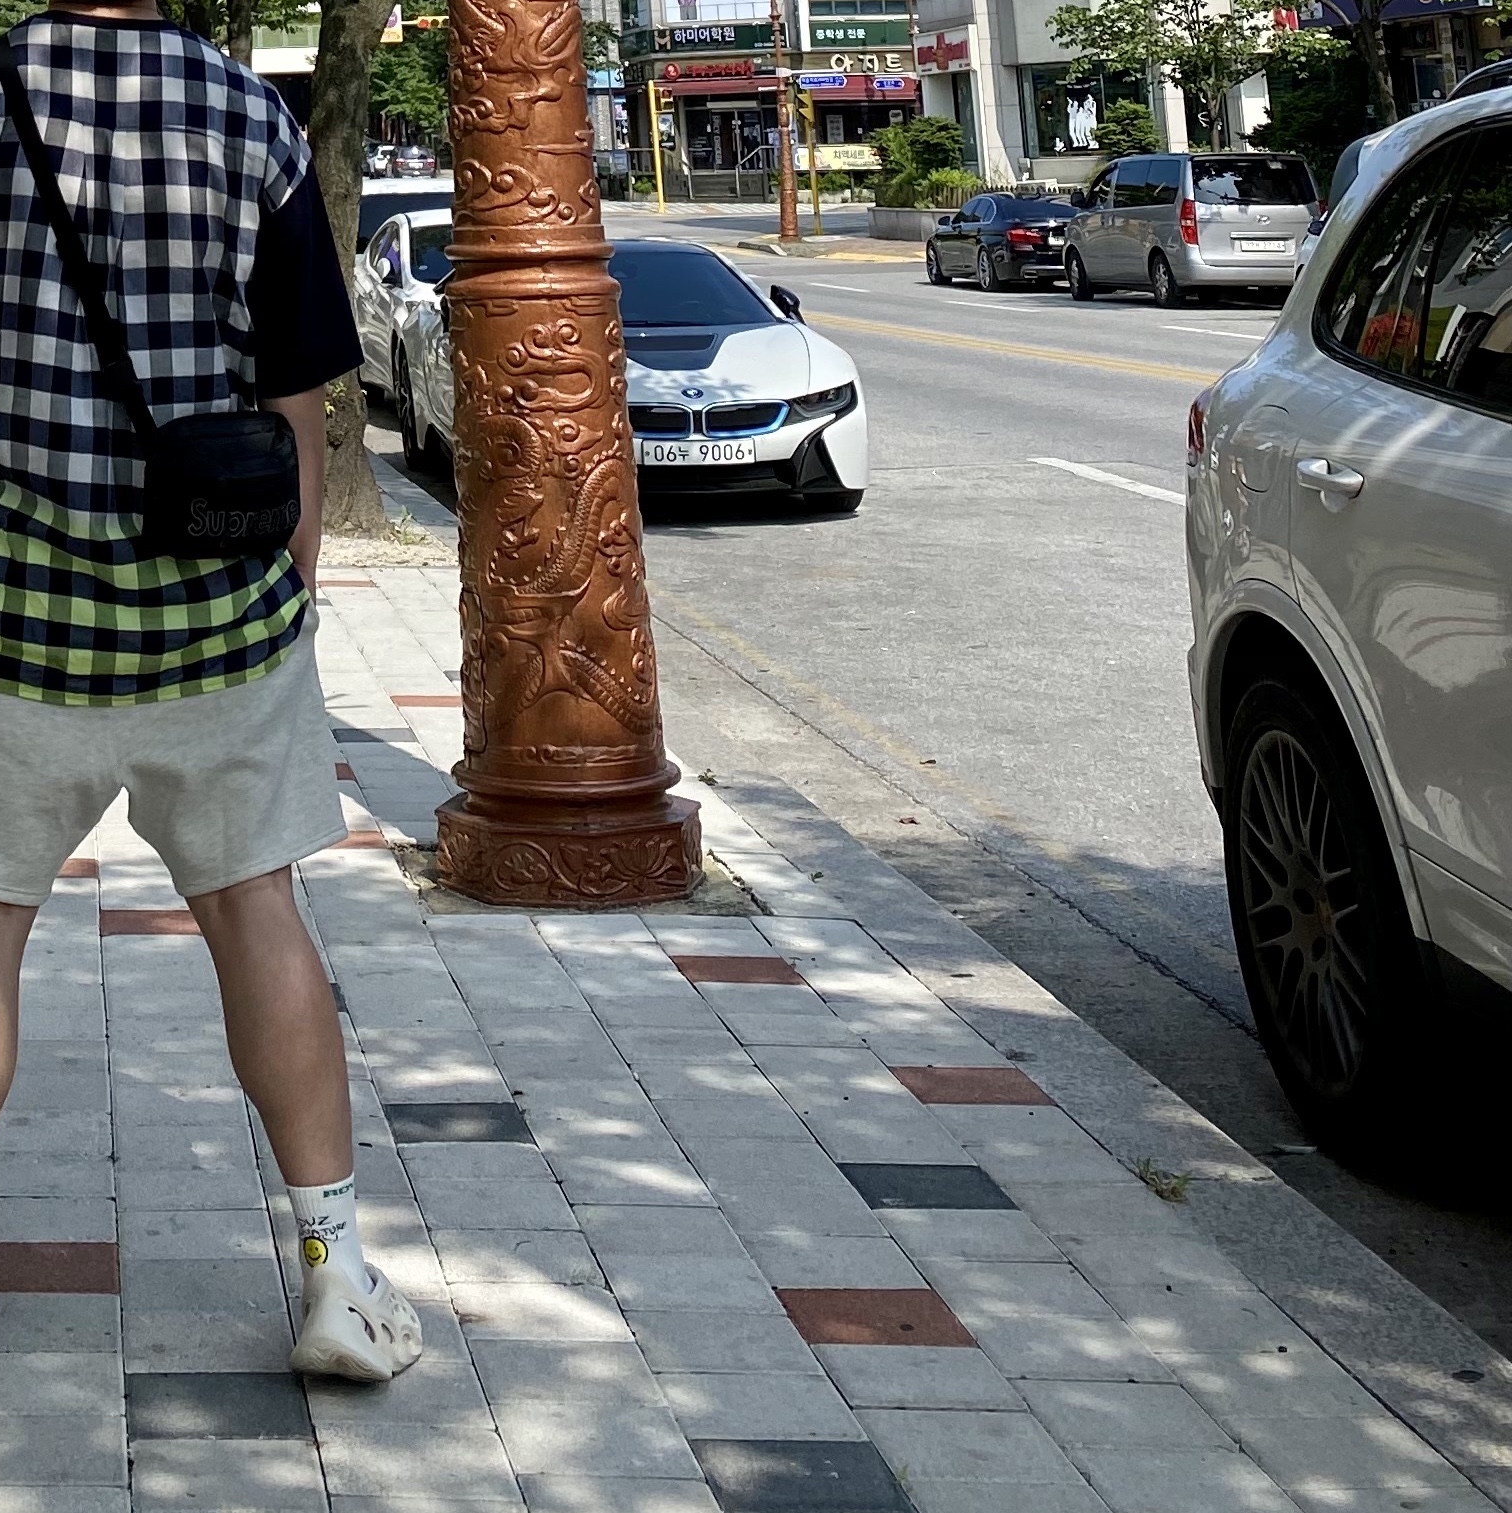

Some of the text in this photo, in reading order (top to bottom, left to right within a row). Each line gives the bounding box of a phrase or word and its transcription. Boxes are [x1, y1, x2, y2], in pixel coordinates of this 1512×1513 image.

[674, 26, 736, 44] 하미어학원
[847, 28, 866, 38] 전문
[830, 53, 904, 73] 아지트
[654, 444, 745, 462] 06누 9006
[187, 497, 299, 537] Supreme
